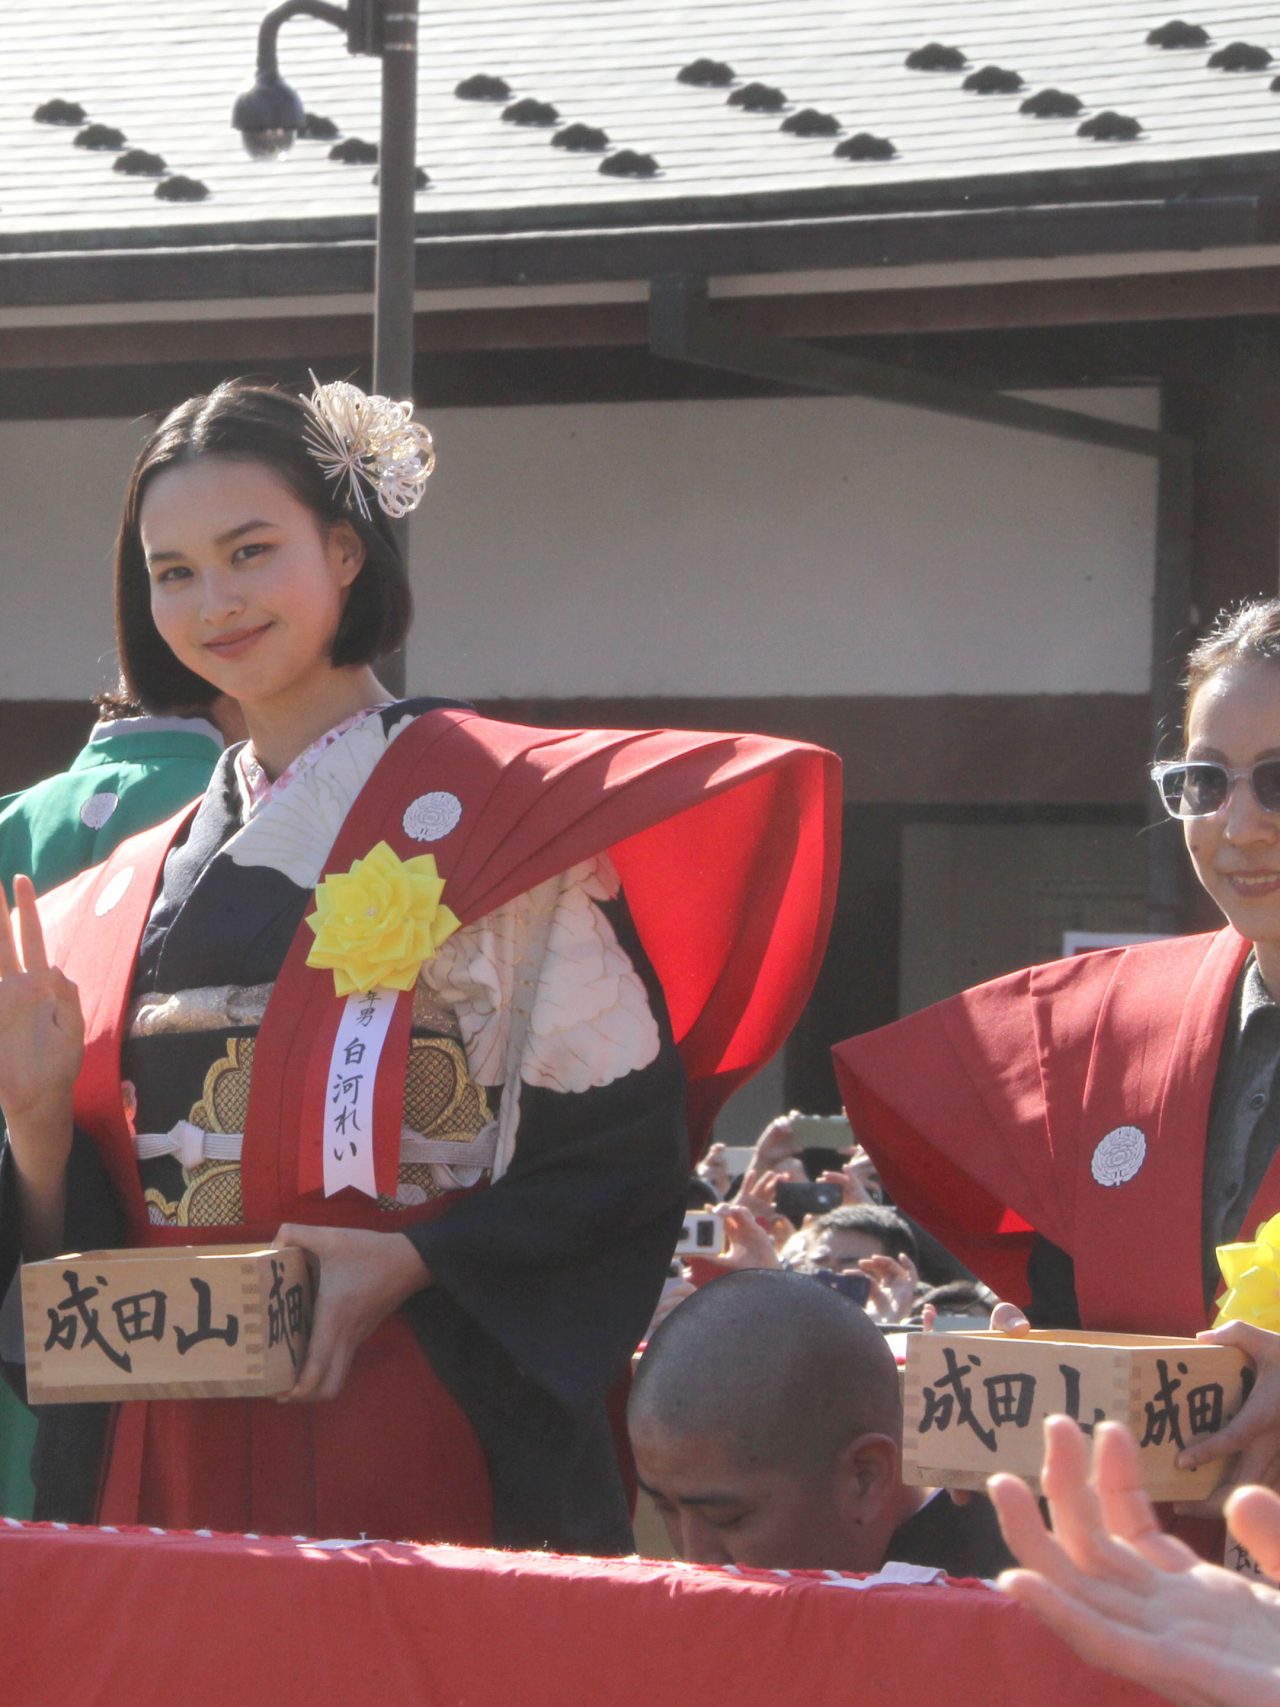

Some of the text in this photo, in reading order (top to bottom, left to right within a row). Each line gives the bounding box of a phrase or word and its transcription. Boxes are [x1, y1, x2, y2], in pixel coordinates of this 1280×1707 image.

[332, 1037, 367, 1161] 白河れい
[44, 1270, 239, 1373] 成田山
[1140, 1358, 1255, 1471] 成田
